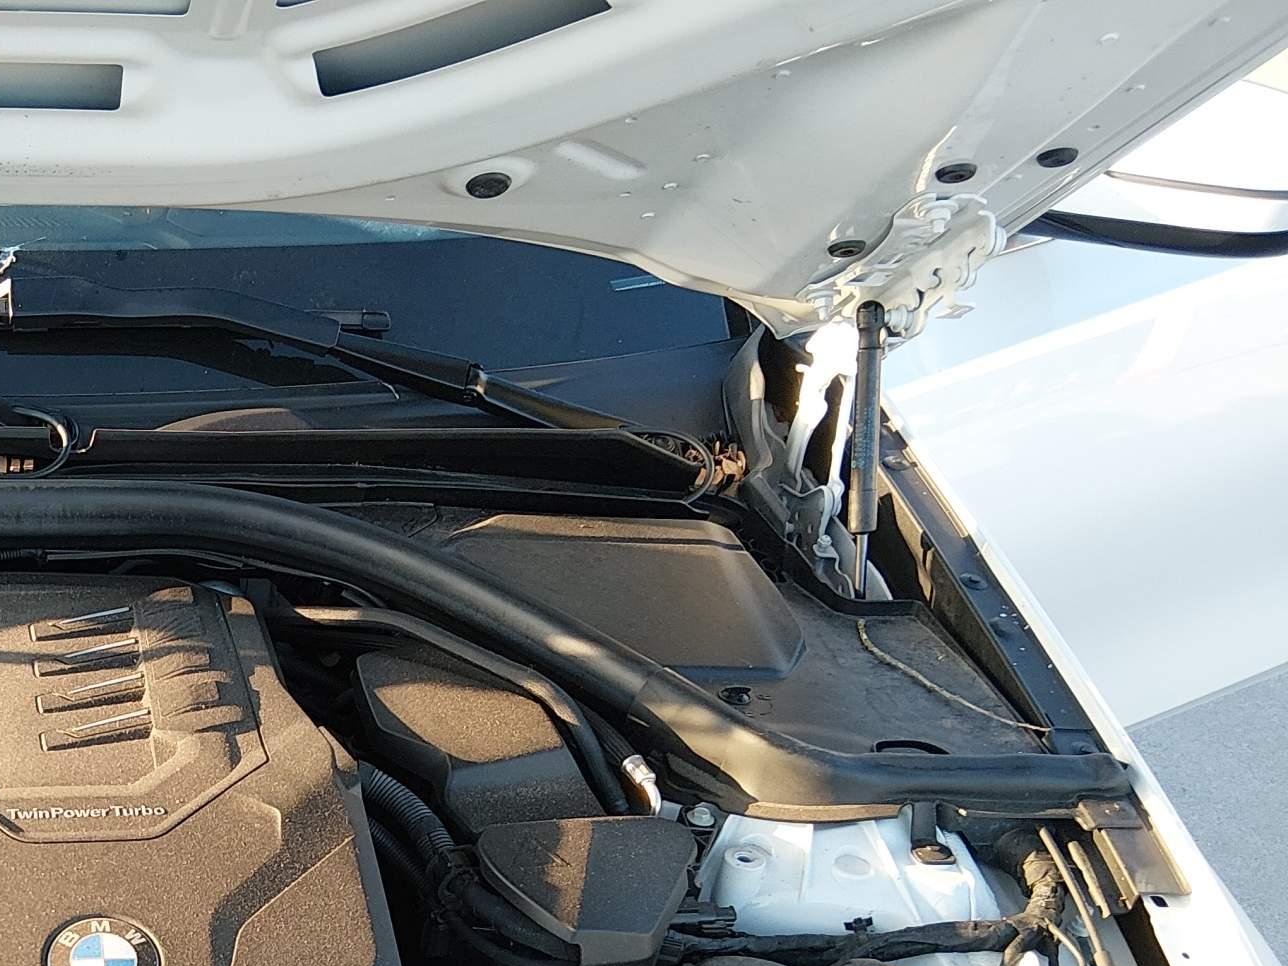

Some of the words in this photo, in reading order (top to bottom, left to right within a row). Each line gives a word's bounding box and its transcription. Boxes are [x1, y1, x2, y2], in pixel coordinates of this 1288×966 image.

[7, 806, 110, 820] TwinPower
[110, 804, 167, 818] Turbo
[58, 919, 148, 948] BMW
